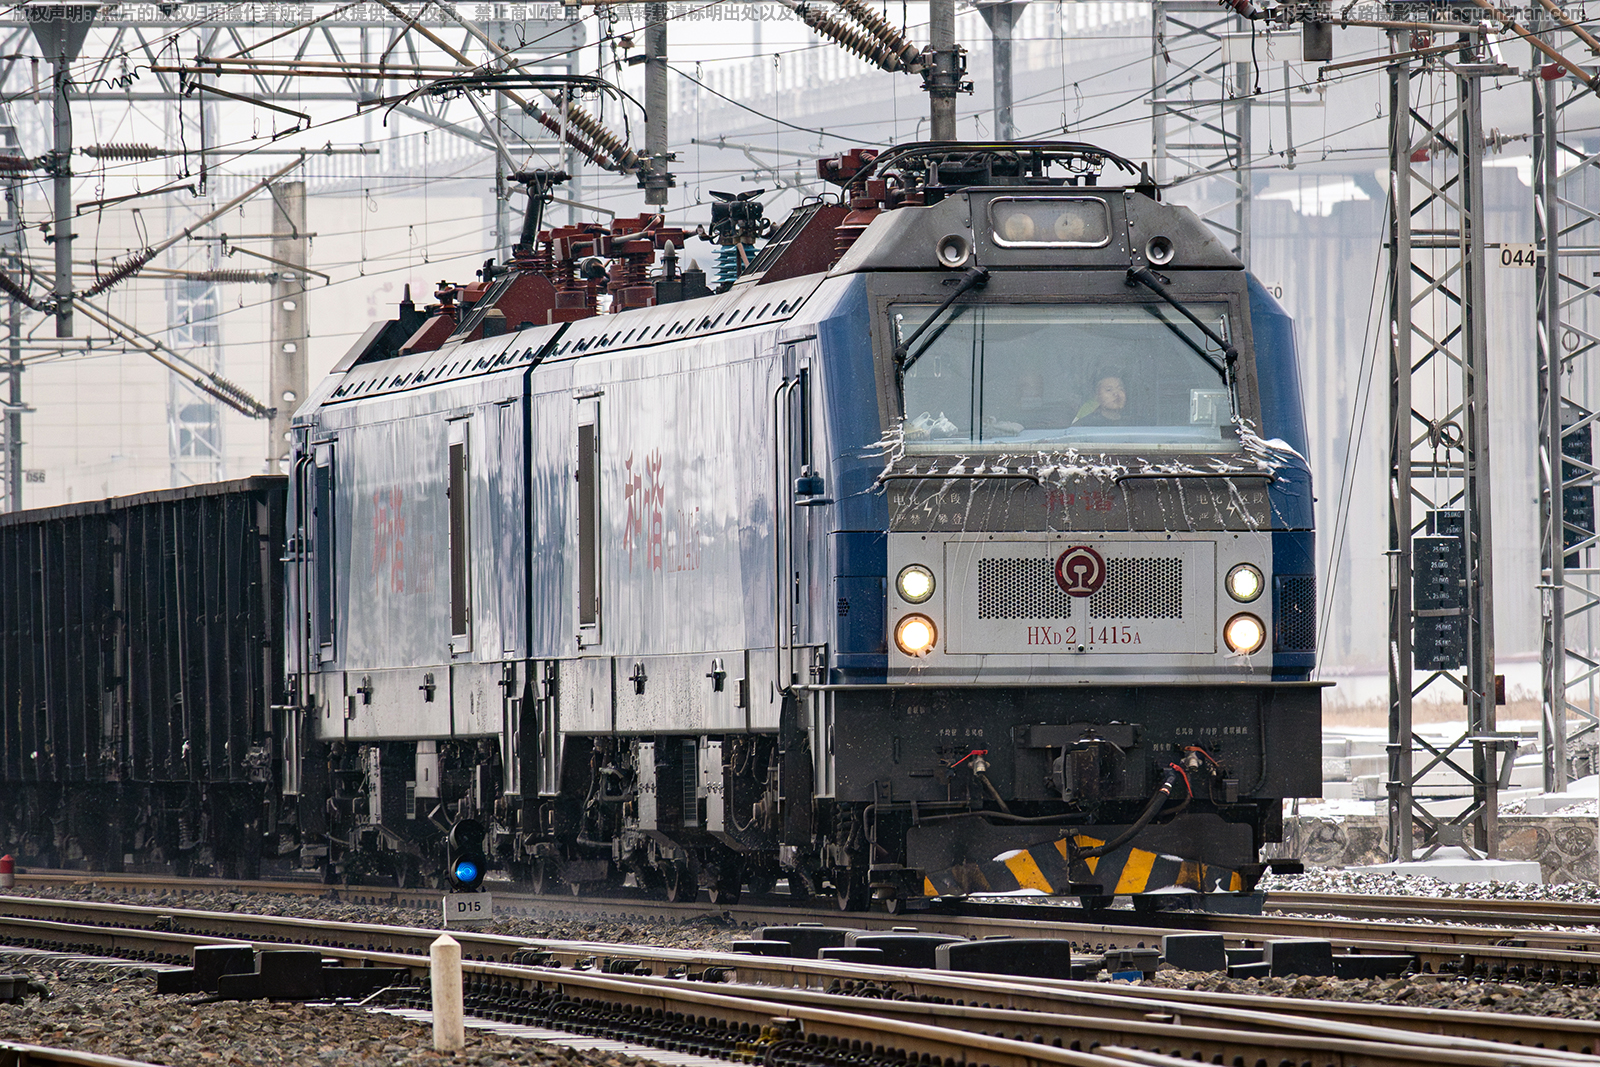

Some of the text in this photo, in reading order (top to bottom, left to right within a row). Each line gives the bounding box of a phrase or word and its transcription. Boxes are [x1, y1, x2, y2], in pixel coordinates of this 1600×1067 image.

[1501, 248, 1536, 267] 044
[622, 446, 665, 574] 和谐
[1088, 625, 1142, 645] 1415A
[457, 901, 482, 913] D15
